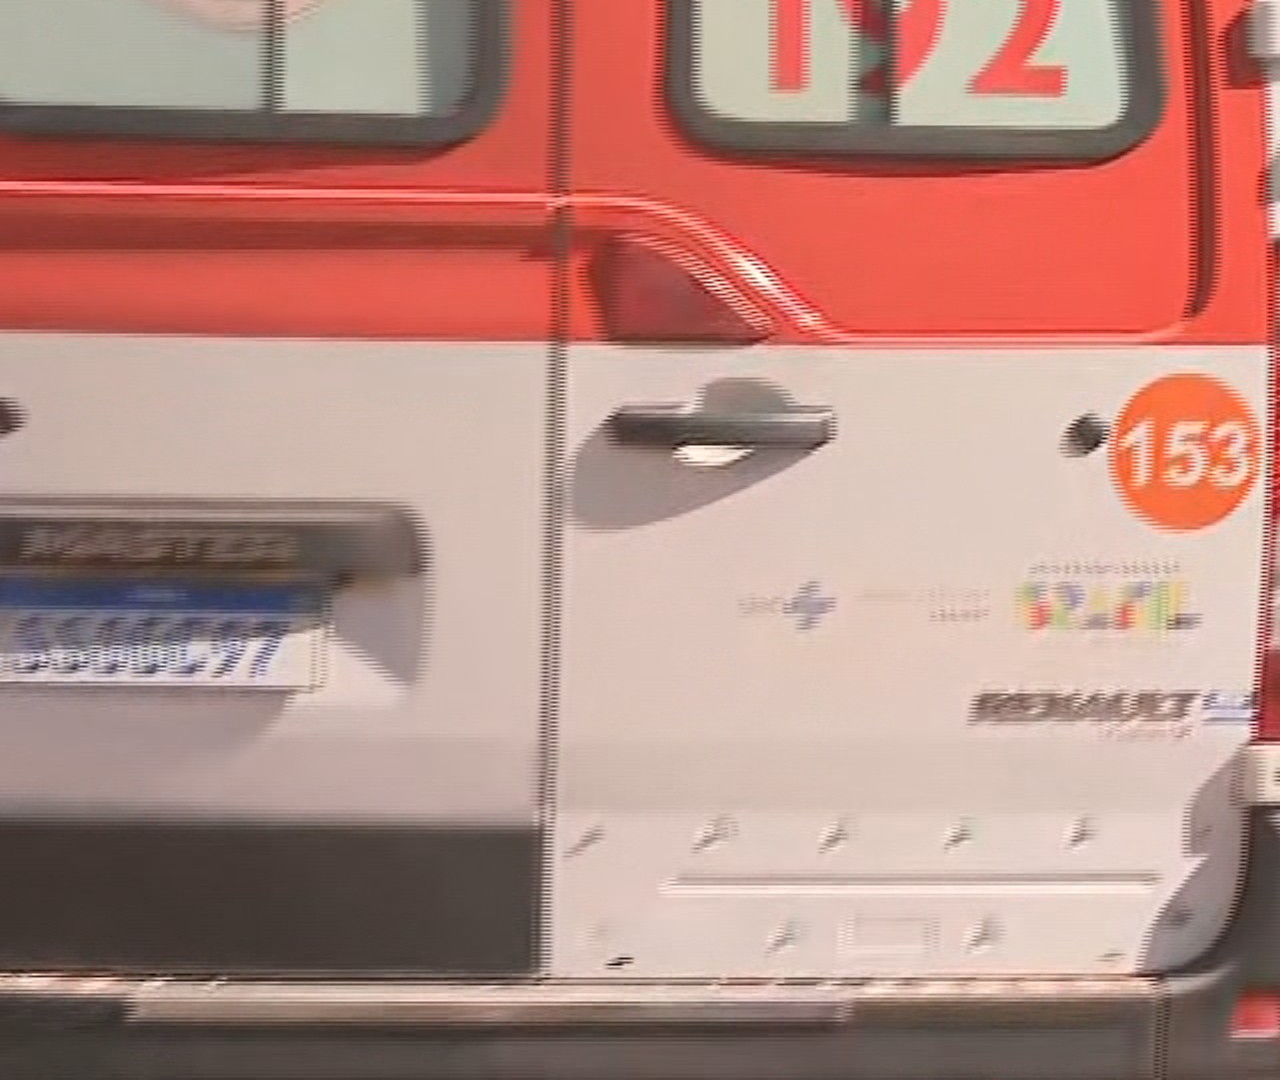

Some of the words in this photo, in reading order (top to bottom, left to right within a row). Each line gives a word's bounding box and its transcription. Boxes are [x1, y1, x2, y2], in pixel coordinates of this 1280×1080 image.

[1119, 421, 1253, 489] 153
[20, 526, 300, 562] MASTER
[967, 689, 1201, 726] RENAULT
